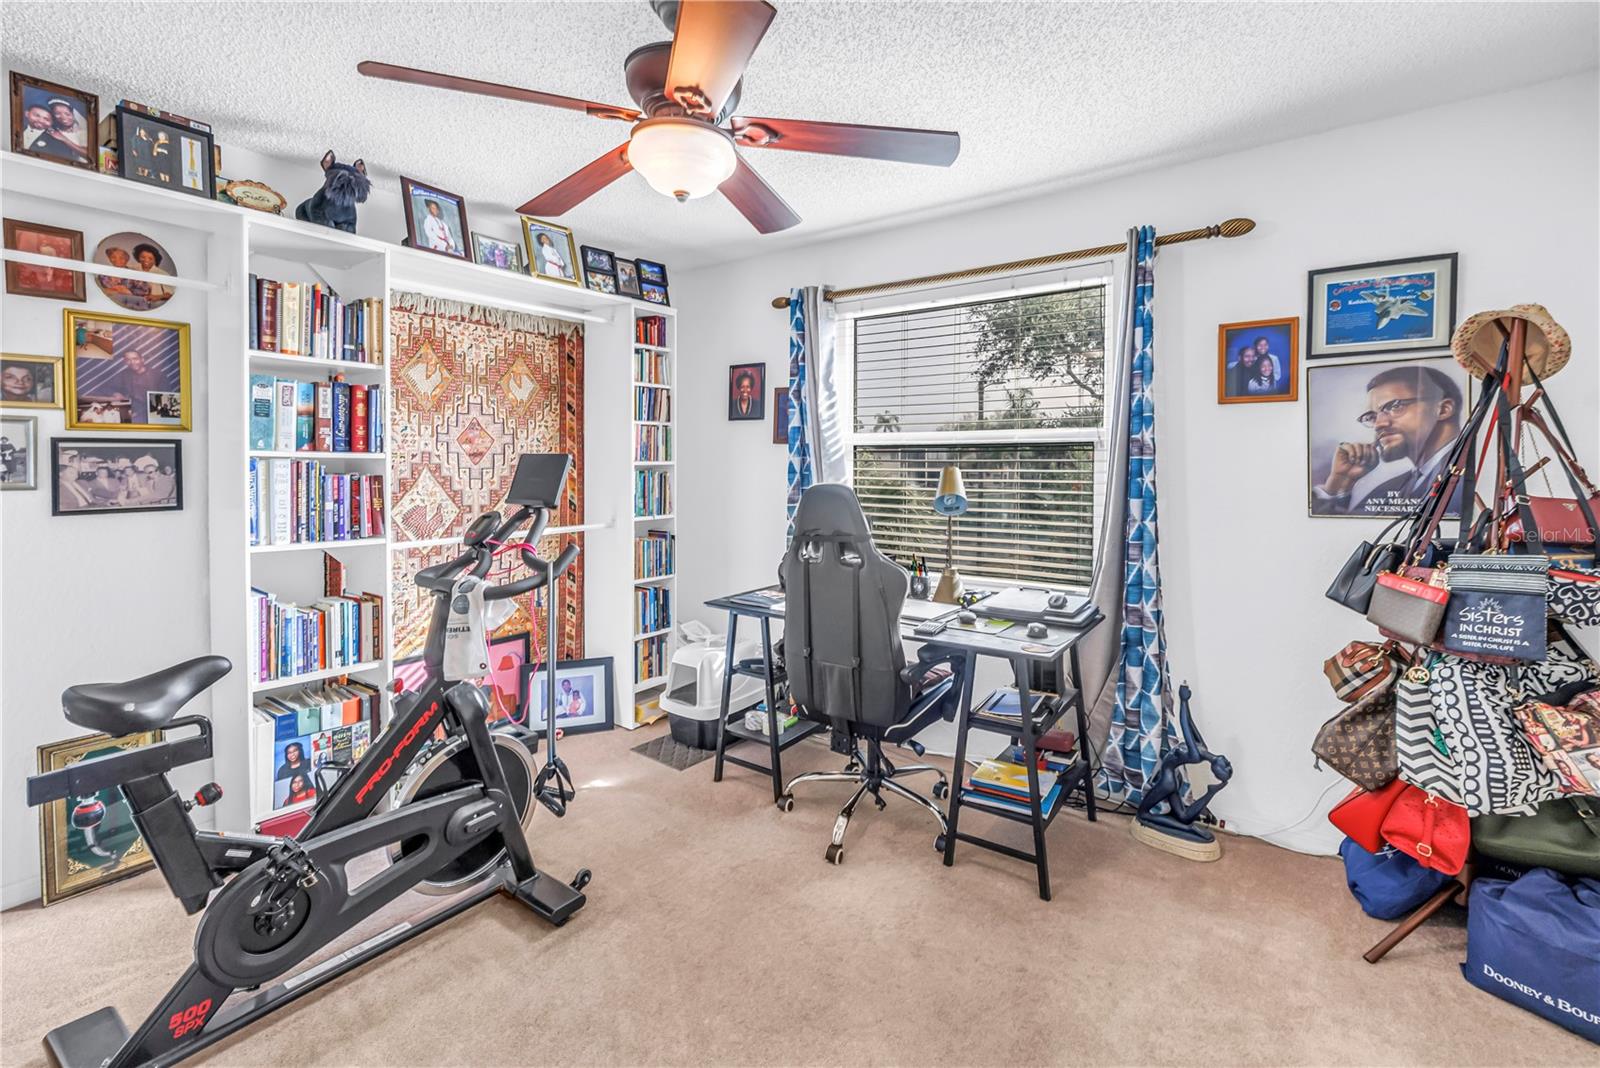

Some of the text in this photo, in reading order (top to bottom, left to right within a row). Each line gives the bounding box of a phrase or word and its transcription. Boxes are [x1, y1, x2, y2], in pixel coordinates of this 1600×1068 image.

[1459, 607, 1524, 626] Sisters
[1460, 623, 1523, 637] IN CHRIST
[1483, 964, 1542, 999] DOONEY
[1543, 994, 1555, 1006] &
[169, 998, 212, 1029] 500
[173, 1014, 206, 1039] SPX
